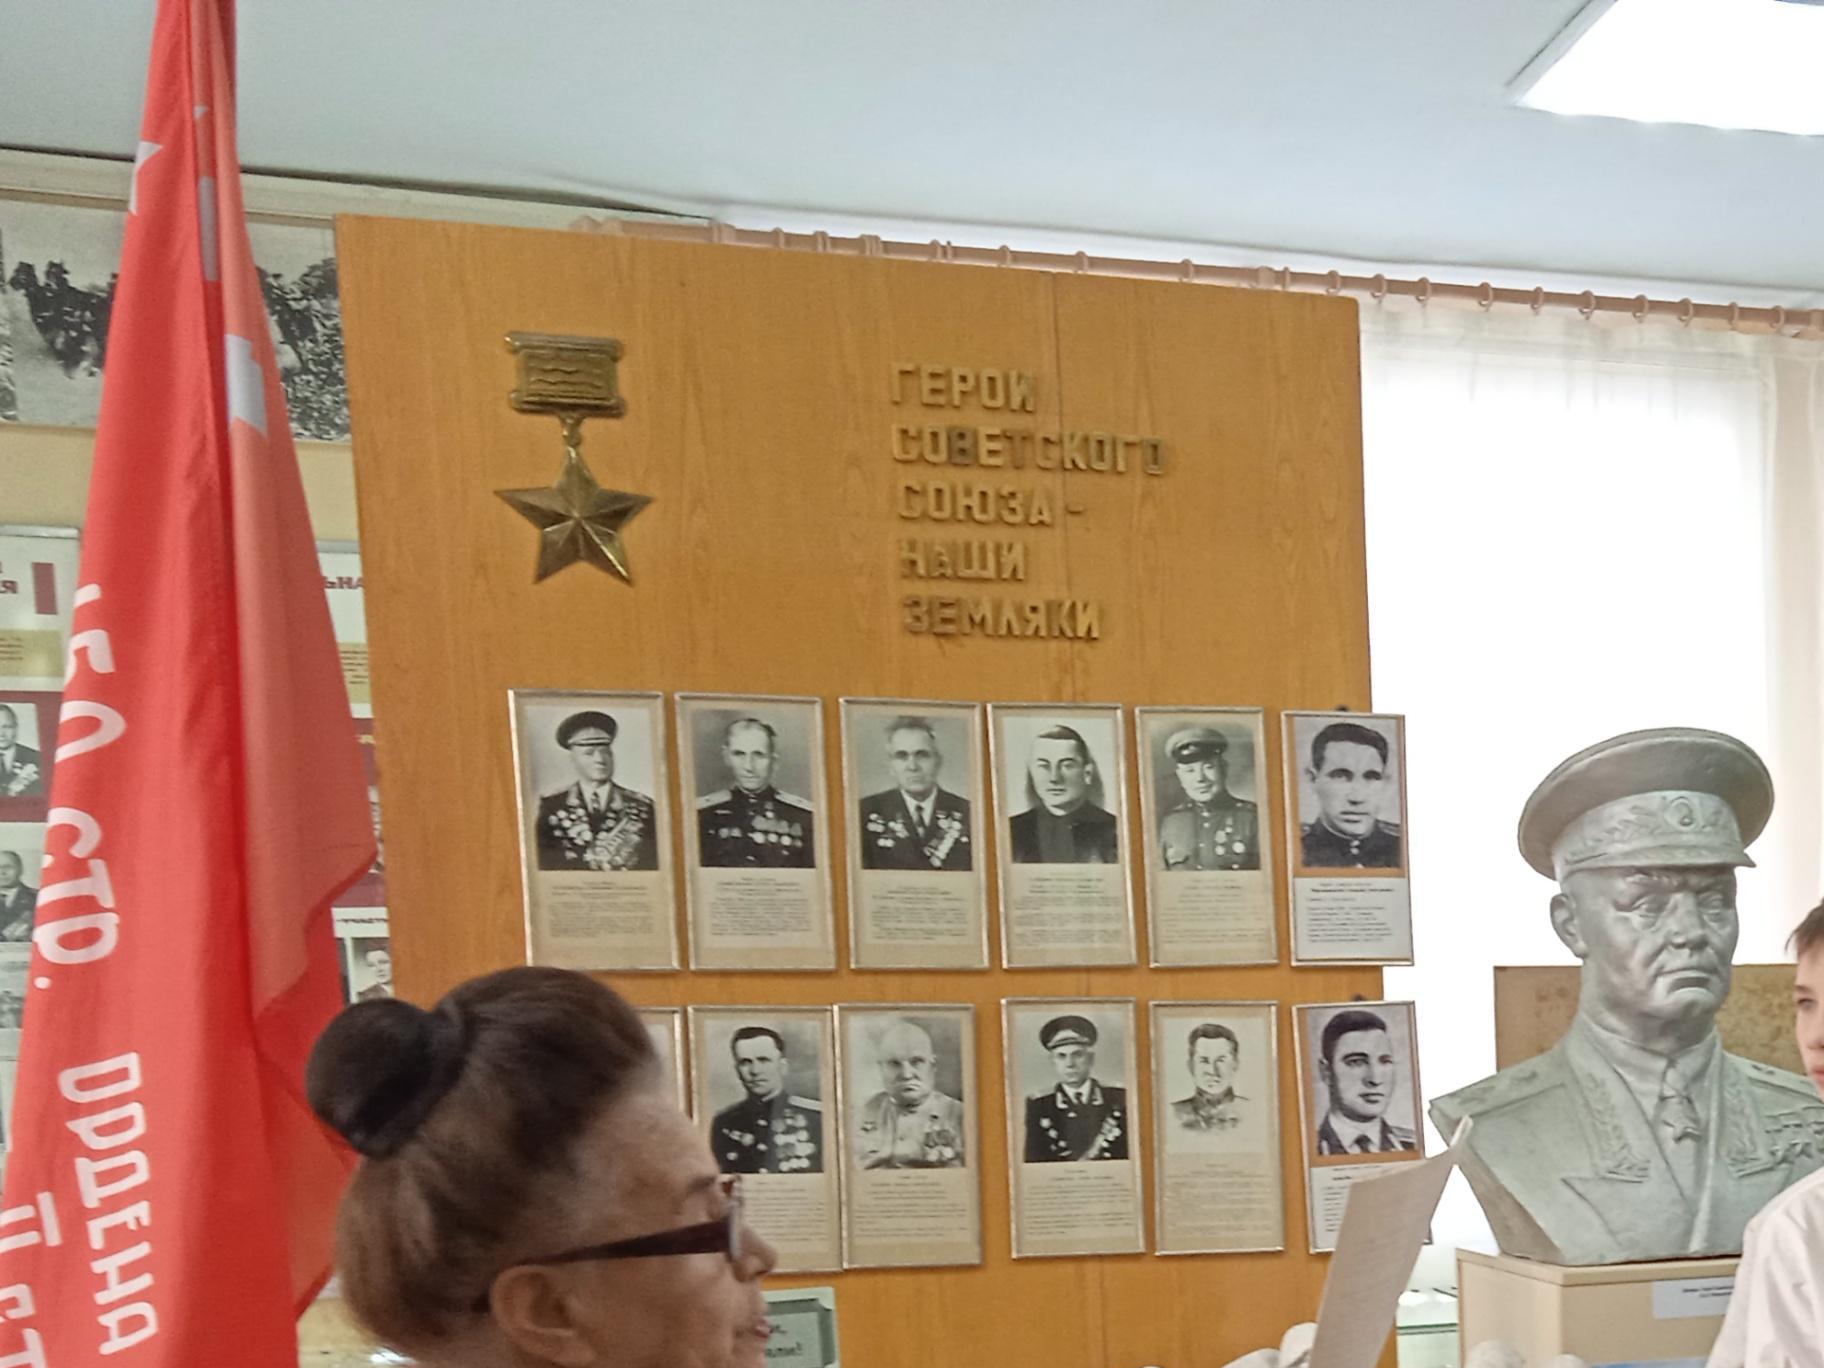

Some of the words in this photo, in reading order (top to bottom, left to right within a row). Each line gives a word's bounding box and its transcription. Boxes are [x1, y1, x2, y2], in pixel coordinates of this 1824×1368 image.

[891, 364, 1037, 413] ГЕРОИ
[891, 425, 1165, 475] СОВЕТСКОГО
[900, 480, 1051, 525] СОЮЗА
[901, 538, 1025, 580] НАШИ
[902, 594, 1102, 639] ЗЕМЛЯКИ
[58, 1052, 159, 1356] ОРДЕНА
